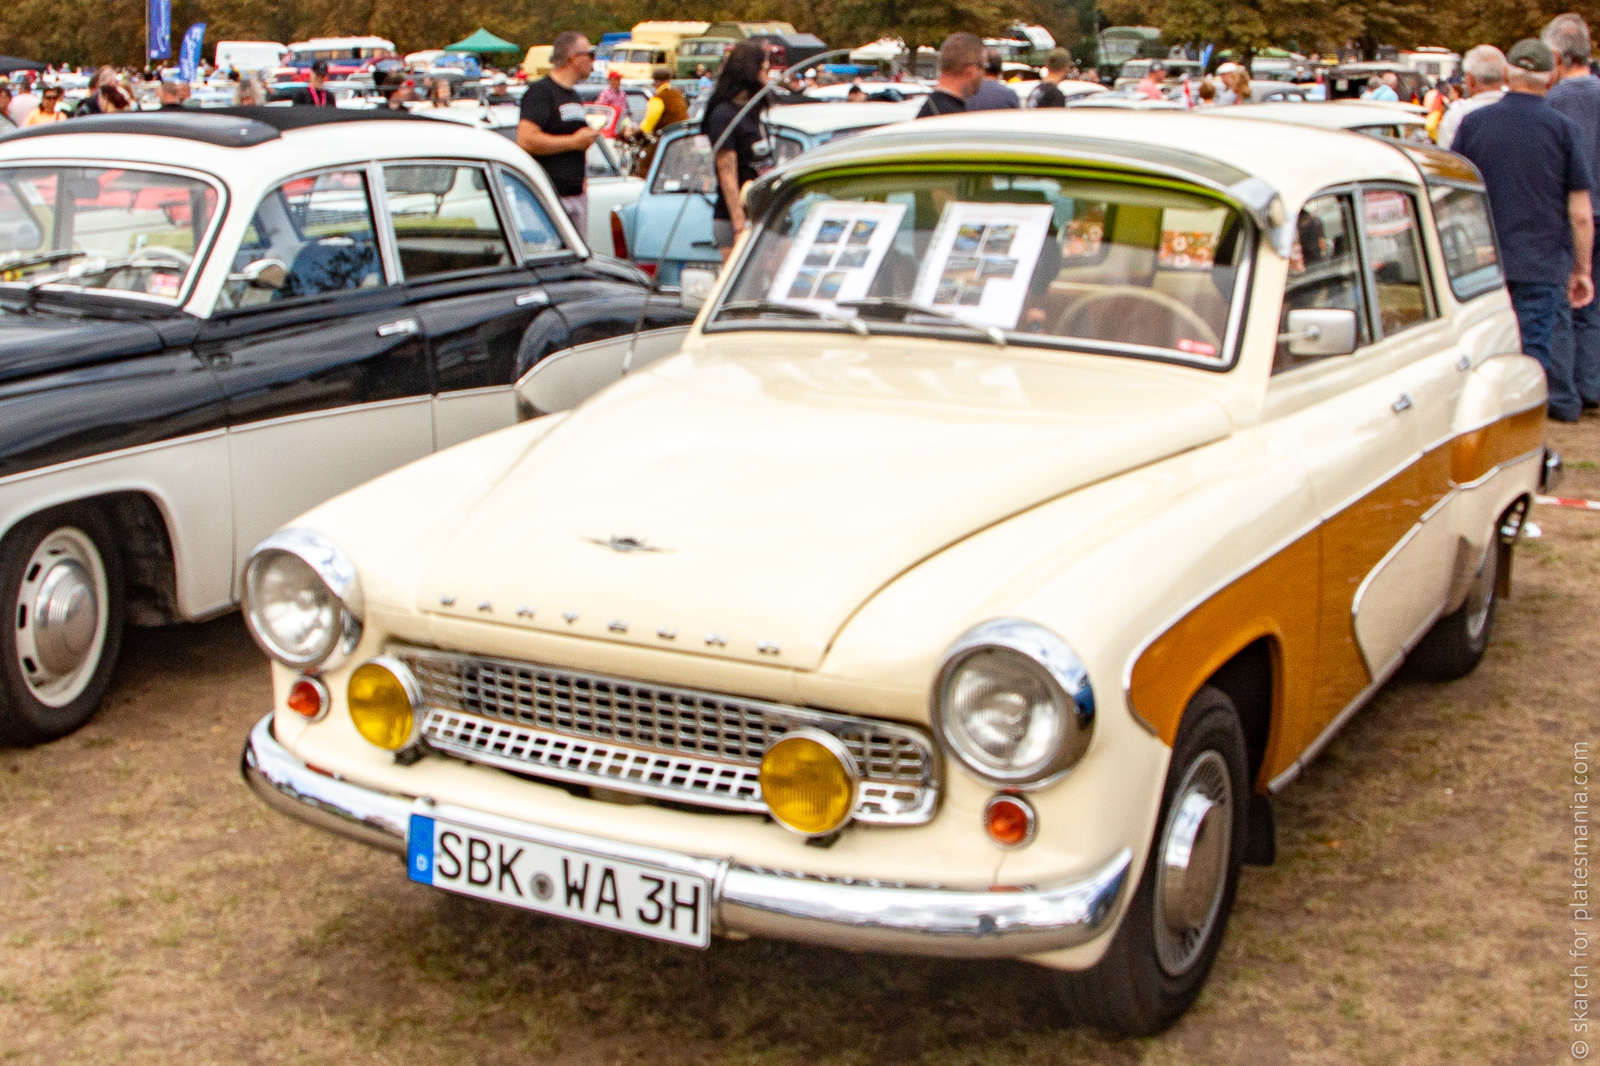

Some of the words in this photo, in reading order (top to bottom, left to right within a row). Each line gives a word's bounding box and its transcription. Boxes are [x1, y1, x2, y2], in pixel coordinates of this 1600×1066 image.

[438, 831, 525, 898] SBK
[562, 857, 621, 919] WA
[637, 874, 701, 935] 3H
